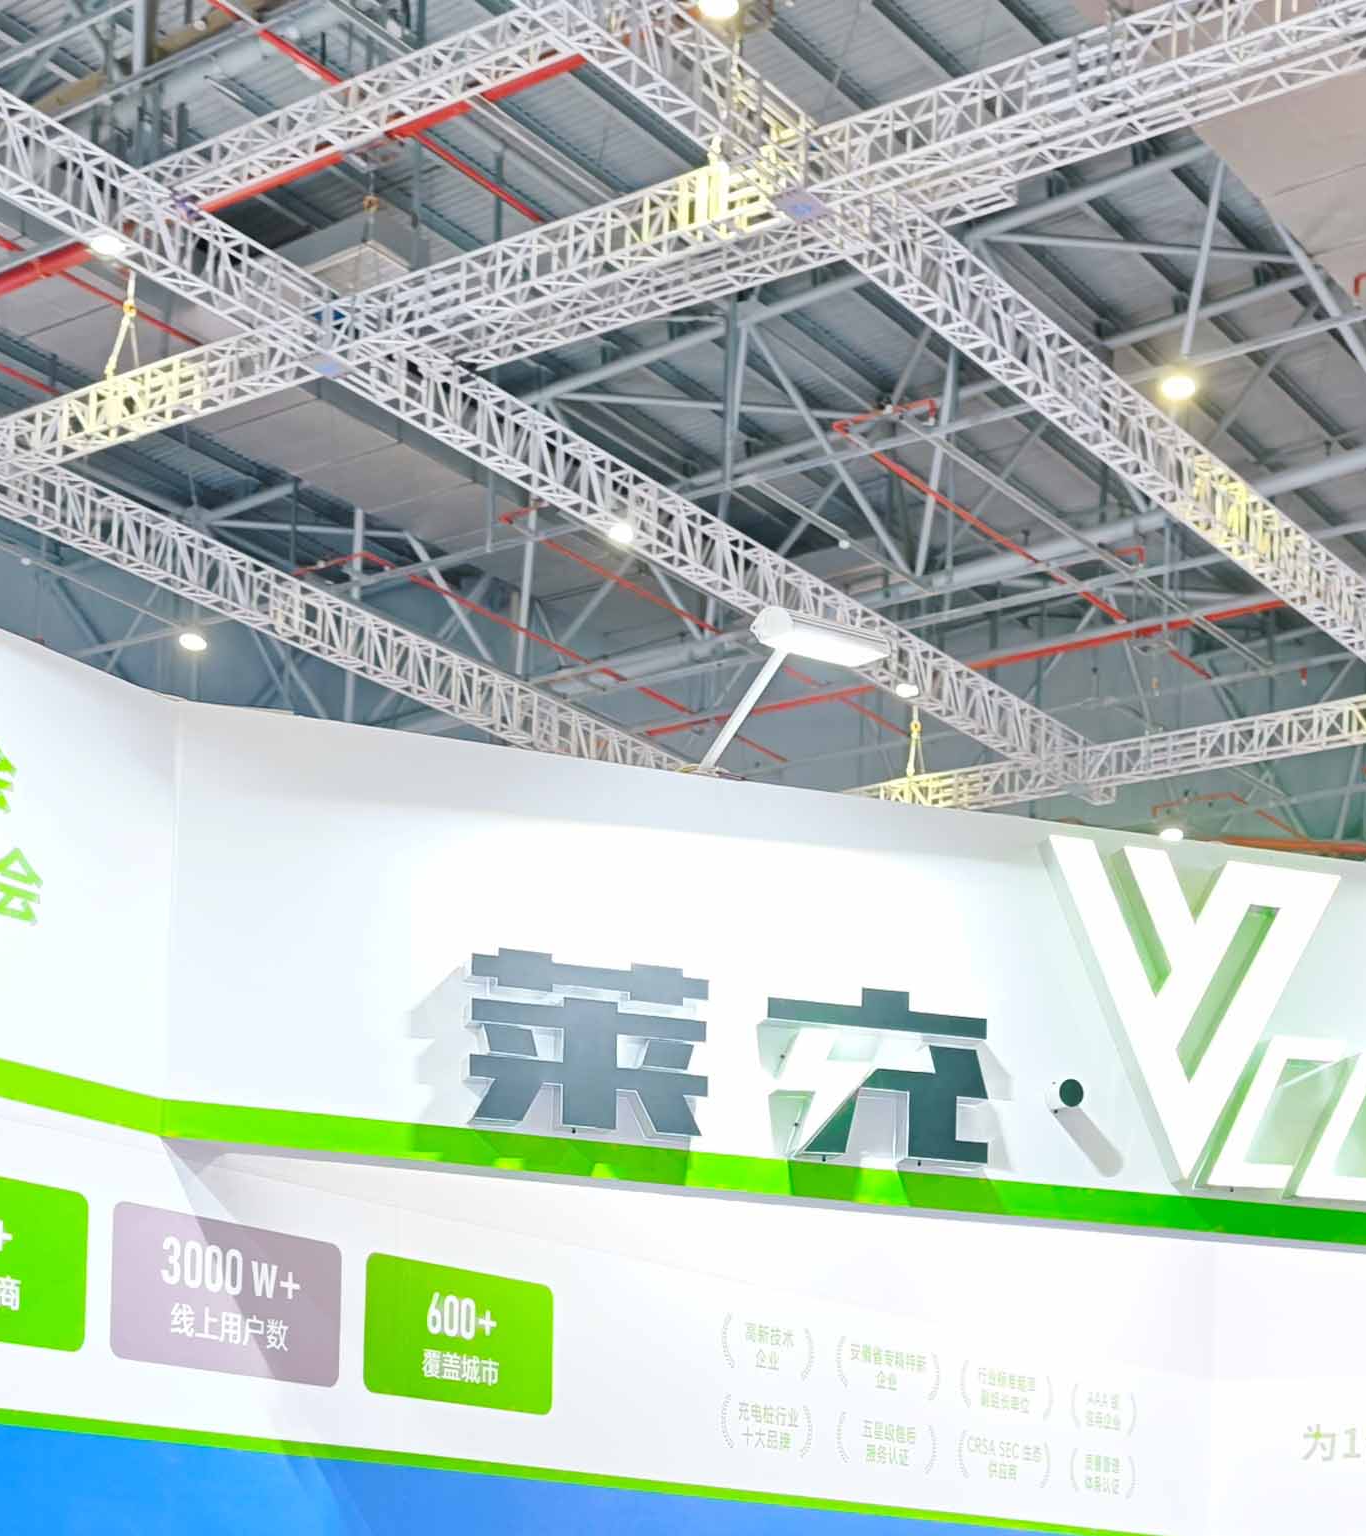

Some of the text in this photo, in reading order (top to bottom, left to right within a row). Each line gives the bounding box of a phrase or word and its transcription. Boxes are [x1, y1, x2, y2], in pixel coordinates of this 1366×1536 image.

[161, 1236, 300, 1300] 3000 W+
[170, 1303, 289, 1352] 线上用户数
[427, 1292, 497, 1340] 600+
[422, 1349, 500, 1386] 覆盖城市
[755, 1349, 779, 1370] 企业
